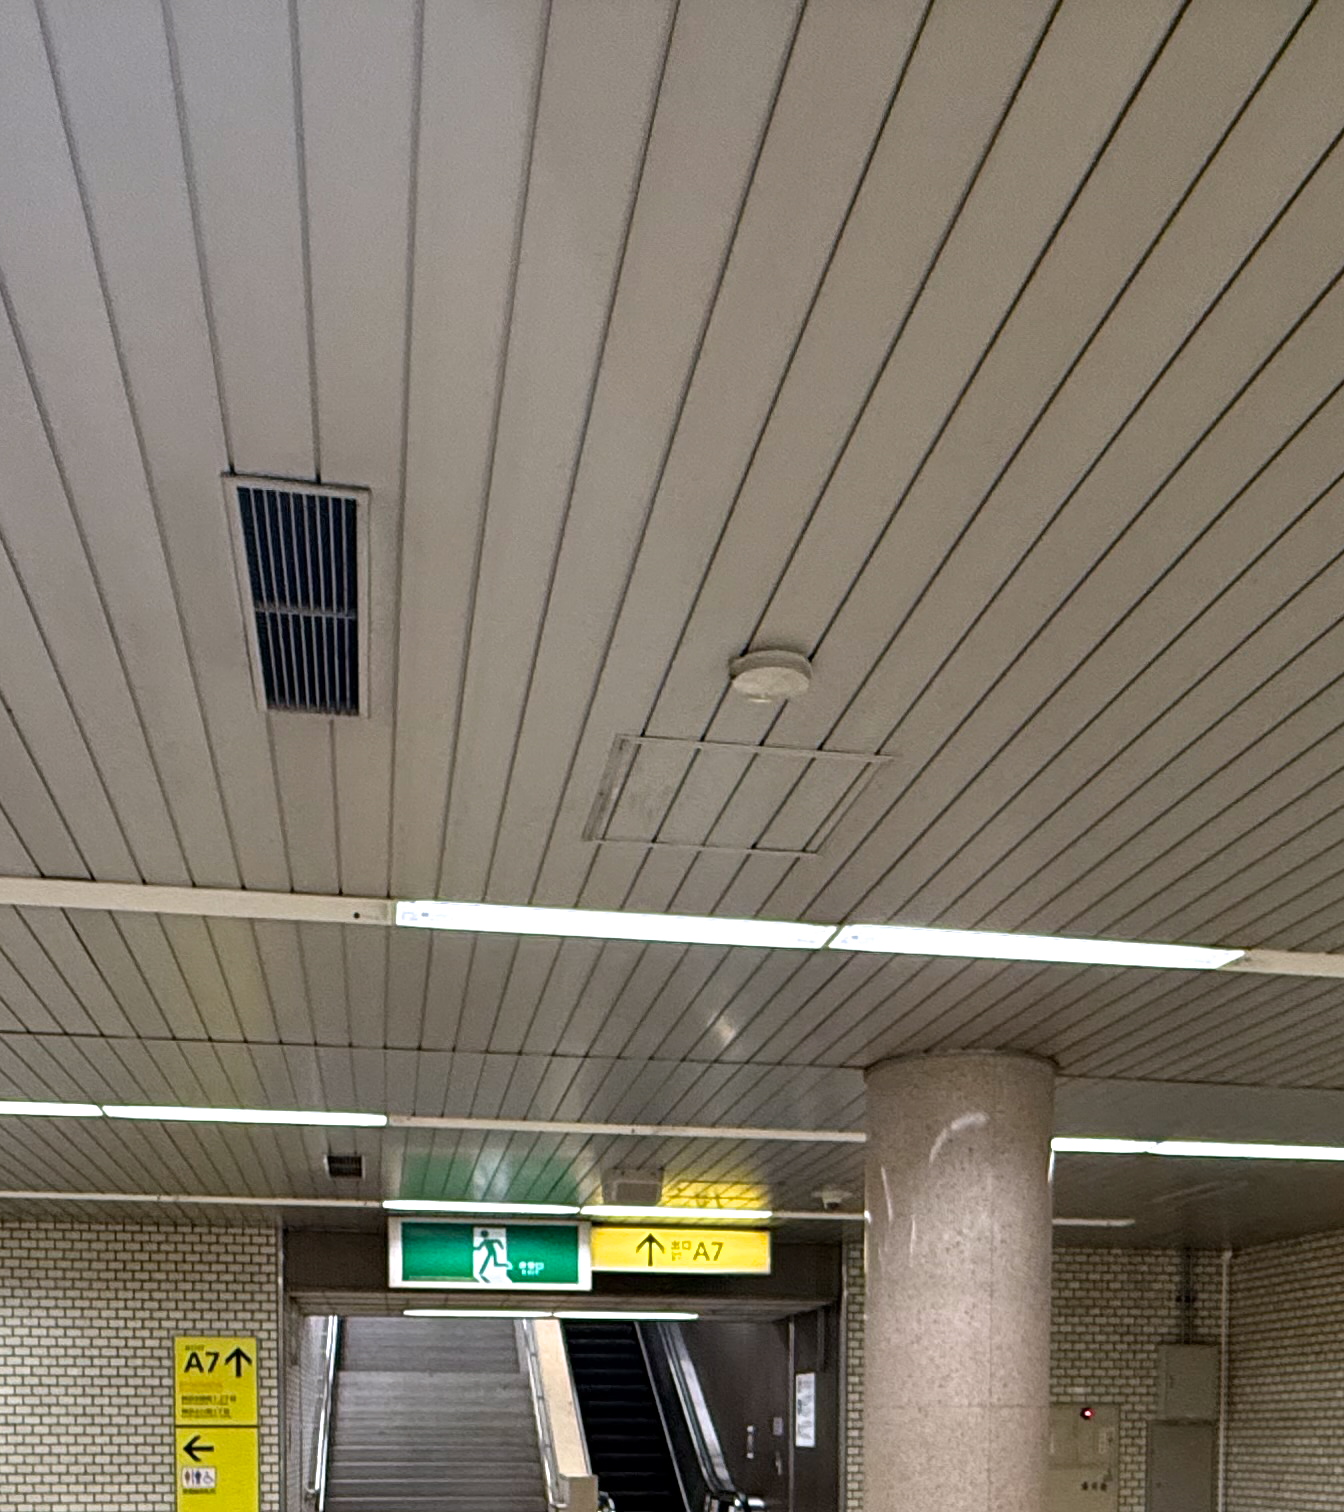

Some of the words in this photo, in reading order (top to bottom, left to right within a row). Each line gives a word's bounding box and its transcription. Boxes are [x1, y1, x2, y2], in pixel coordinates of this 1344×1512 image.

[671, 1240, 692, 1250] 出口
[692, 1241, 724, 1262] A7
[183, 1351, 220, 1374] A7
